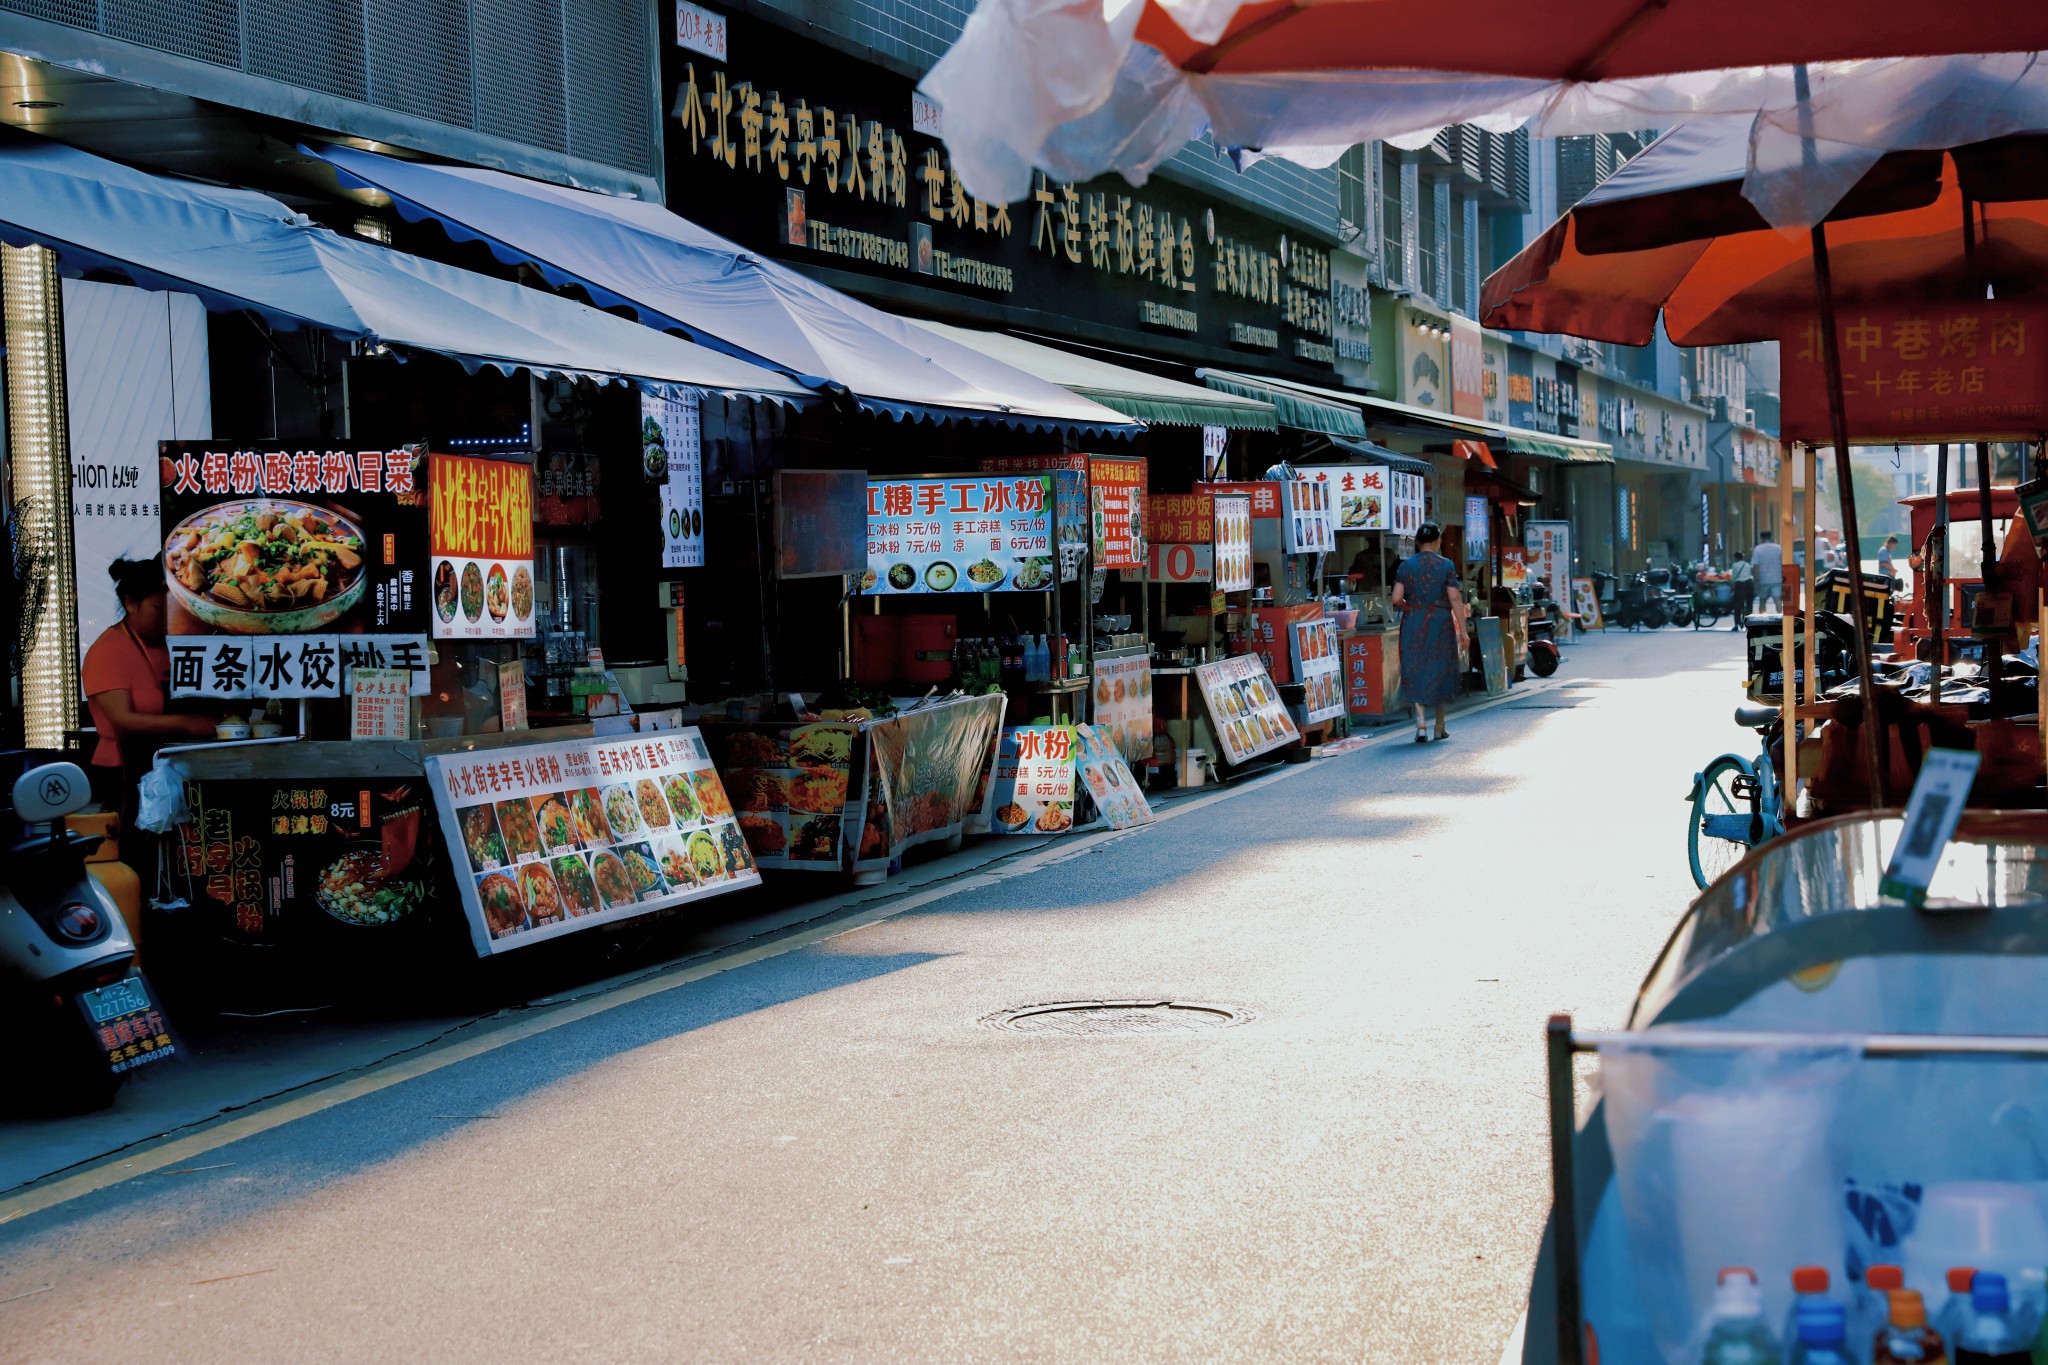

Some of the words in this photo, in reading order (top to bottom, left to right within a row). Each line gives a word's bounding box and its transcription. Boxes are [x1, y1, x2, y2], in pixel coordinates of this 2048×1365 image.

[678, 9, 725, 54] 20年老店
[912, 99, 944, 133] 20年老
[810, 218, 910, 269] TEL:13778857848
[934, 249, 1014, 293] TEL:13778837585
[1044, 456, 1085, 470] 10元/份
[433, 457, 532, 556] 小北街老字号火锅粉
[906, 521, 942, 536] 5元/份
[952, 519, 1002, 535] 手工凉糕
[1010, 517, 1047, 532] 5元/份
[906, 540, 942, 554] 7元/份
[1010, 535, 1047, 551] 6元/份
[172, 644, 250, 692] 面条
[258, 642, 336, 692] 水饺
[448, 753, 563, 799] 小北街老字号火锅粉
[1036, 765, 1069, 779] 5元/份
[1036, 782, 1069, 796] 6元/份
[271, 789, 329, 811] 火锅粉
[330, 802, 356, 819] 8元
[271, 813, 329, 836] 酸辣粉
[234, 835, 264, 935] 火锅粉
